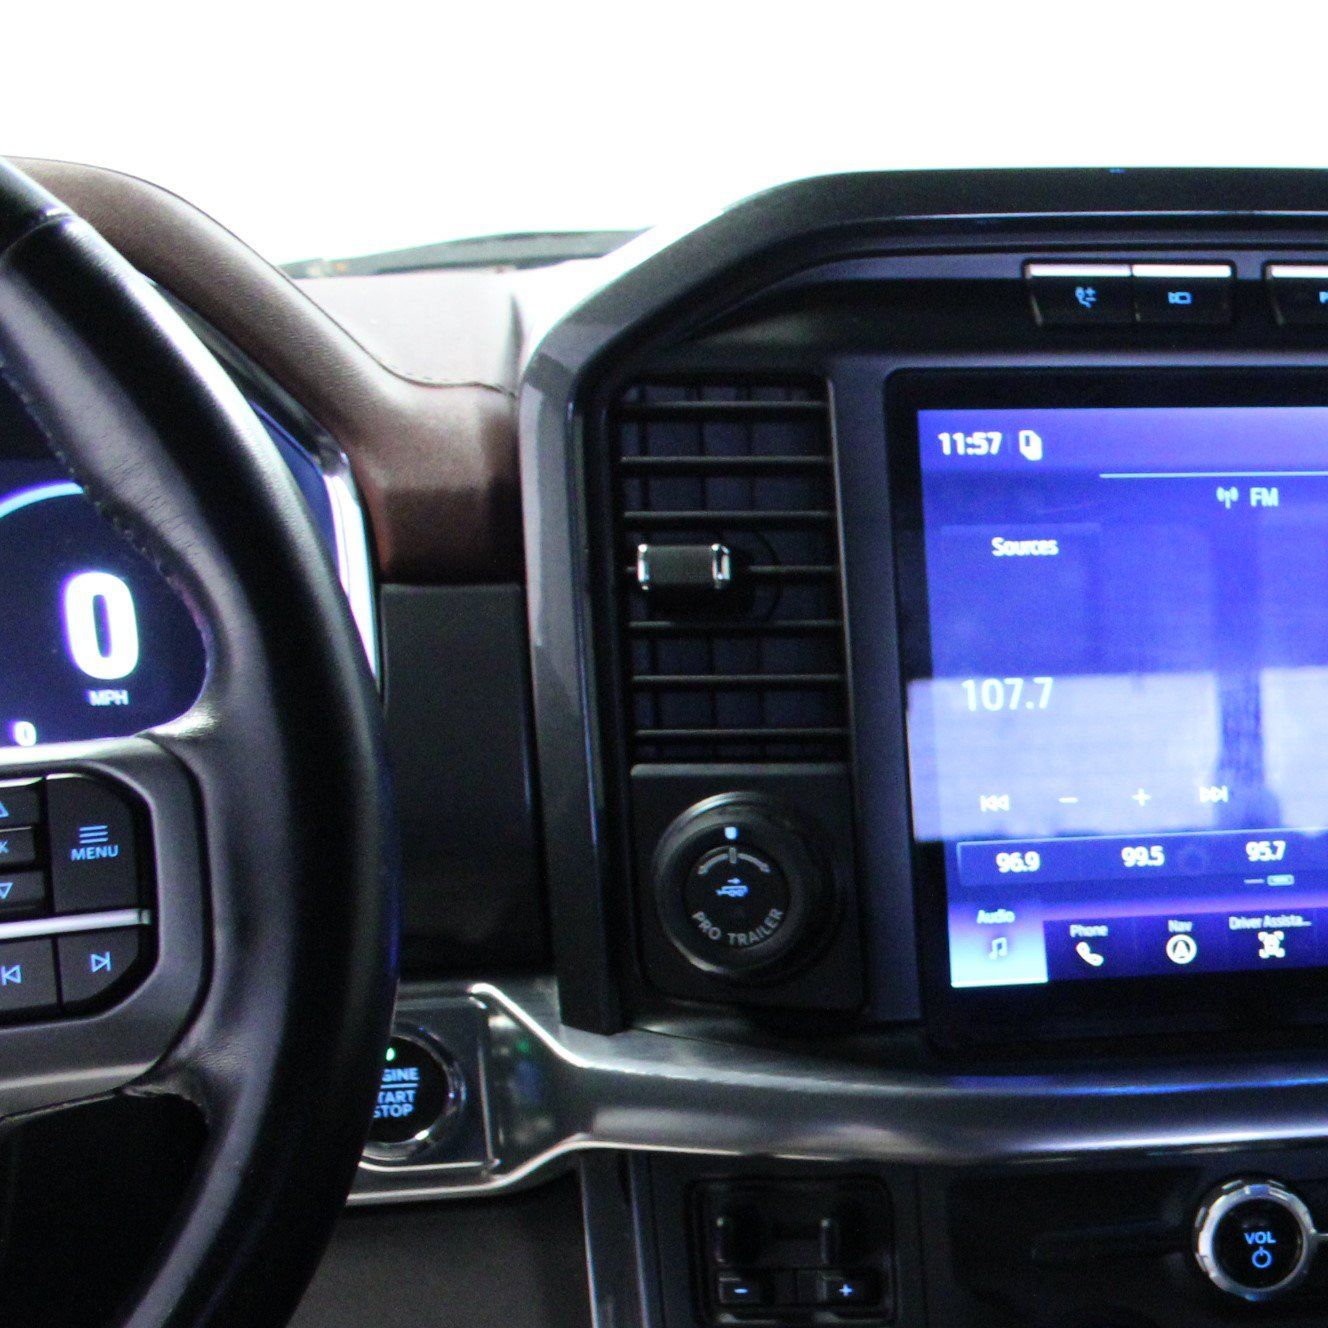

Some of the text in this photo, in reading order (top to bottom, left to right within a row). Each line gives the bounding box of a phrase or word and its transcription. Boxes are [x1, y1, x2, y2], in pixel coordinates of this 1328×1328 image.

[938, 432, 1002, 455] 11:57
[1250, 487, 1279, 507] FM
[991, 537, 1059, 557] Sources
[64, 571, 139, 680] 0
[88, 690, 130, 706] MPH
[961, 676, 1053, 712] 107.7
[71, 844, 119, 861] MENU
[1121, 846, 1165, 867] 99.5
[1246, 840, 1286, 861] 95.7
[996, 851, 1040, 873] 96.9
[692, 908, 783, 946] PRO TRAILER
[977, 909, 1015, 925] Audio
[1168, 919, 1193, 933] Nav
[1070, 923, 1108, 939] Phone
[1245, 1231, 1276, 1245] VOL
